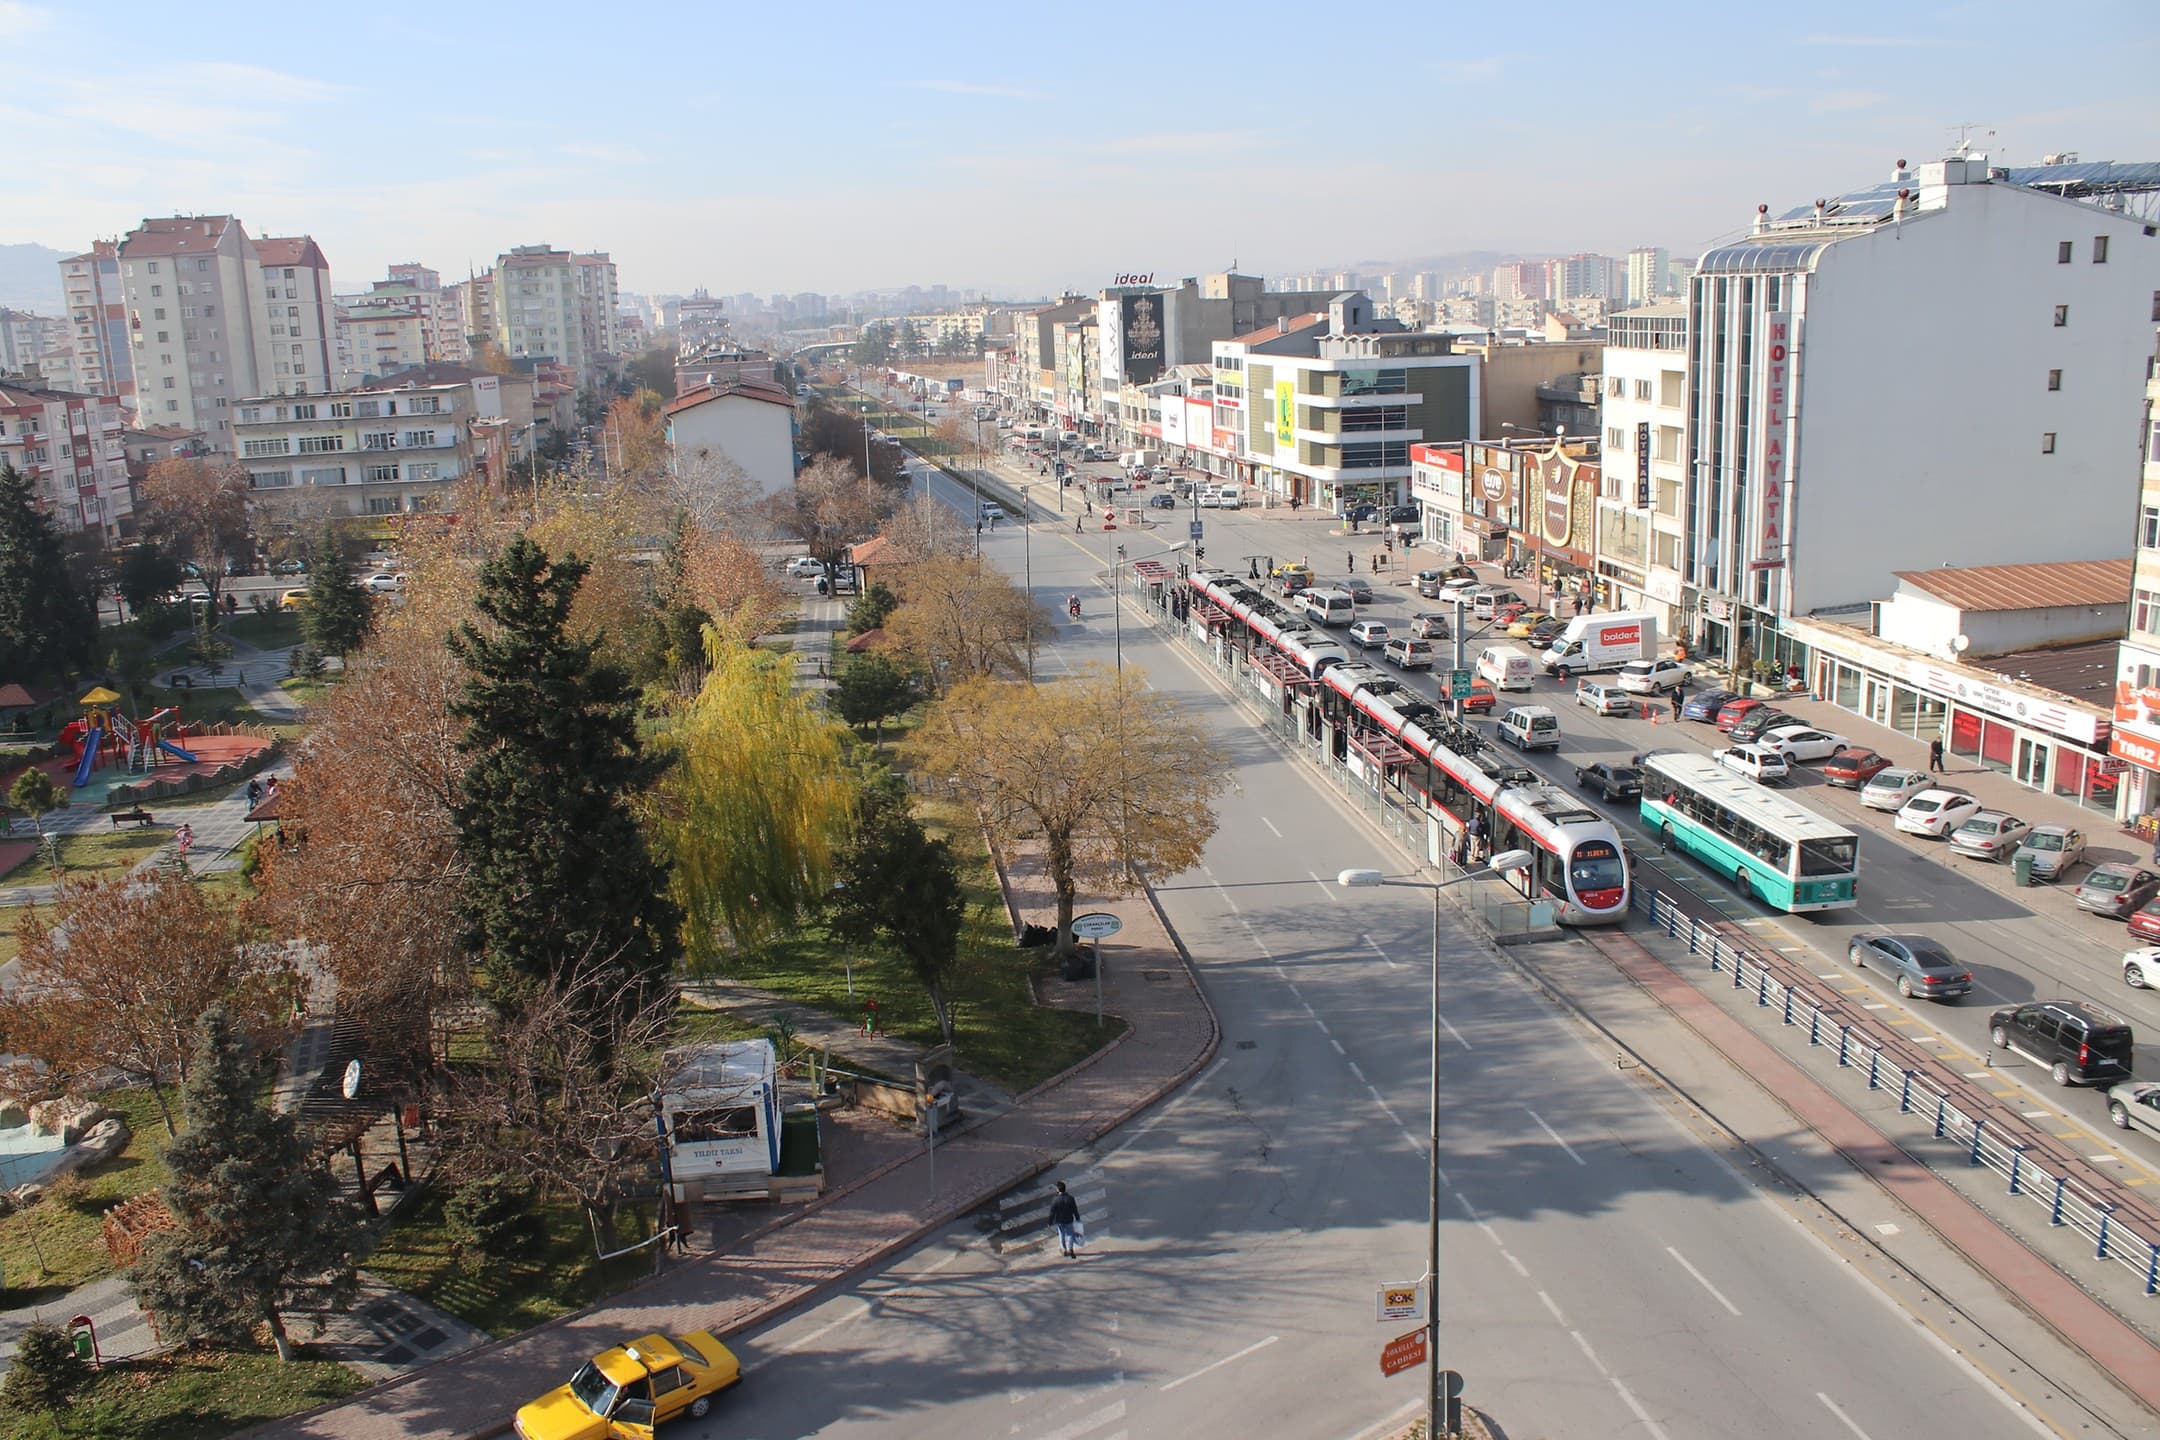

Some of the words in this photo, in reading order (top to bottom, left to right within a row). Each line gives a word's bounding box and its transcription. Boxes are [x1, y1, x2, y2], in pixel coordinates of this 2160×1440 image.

[1114, 272, 1154, 285] ideal
[1132, 351, 1158, 359] ideal
[1770, 323, 1786, 426] HOTEL
[1639, 424, 1648, 465] HOTEL
[1484, 473, 1502, 490] esse
[1639, 470, 1648, 502] ARIN
[1765, 439, 1782, 539] AYATA
[2119, 739, 2155, 764] TARZ
[2103, 759, 2129, 769] TARZ
[693, 1150, 718, 1158] YILDIZ
